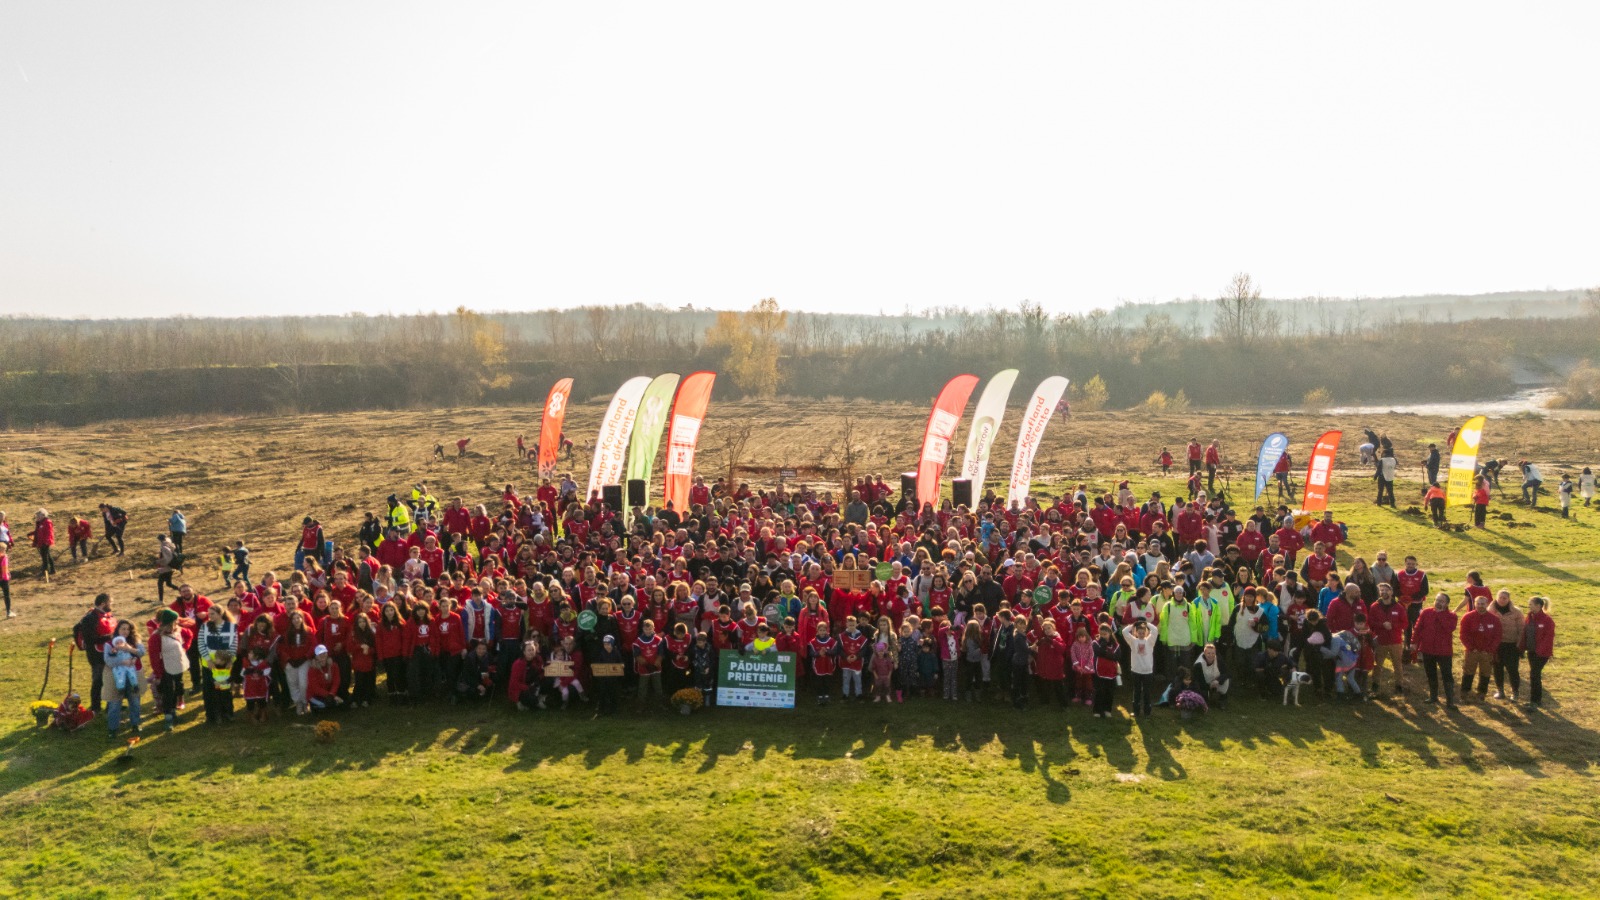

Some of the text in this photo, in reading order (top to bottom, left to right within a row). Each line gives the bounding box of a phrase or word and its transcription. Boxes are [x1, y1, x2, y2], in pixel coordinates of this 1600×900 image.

[592, 398, 627, 491] Echipa Kaufland
[1012, 396, 1045, 489] Echipa Kaufland
[727, 671, 787, 683] PRIETENIEI
[730, 660, 783, 673] PĂDUREA
